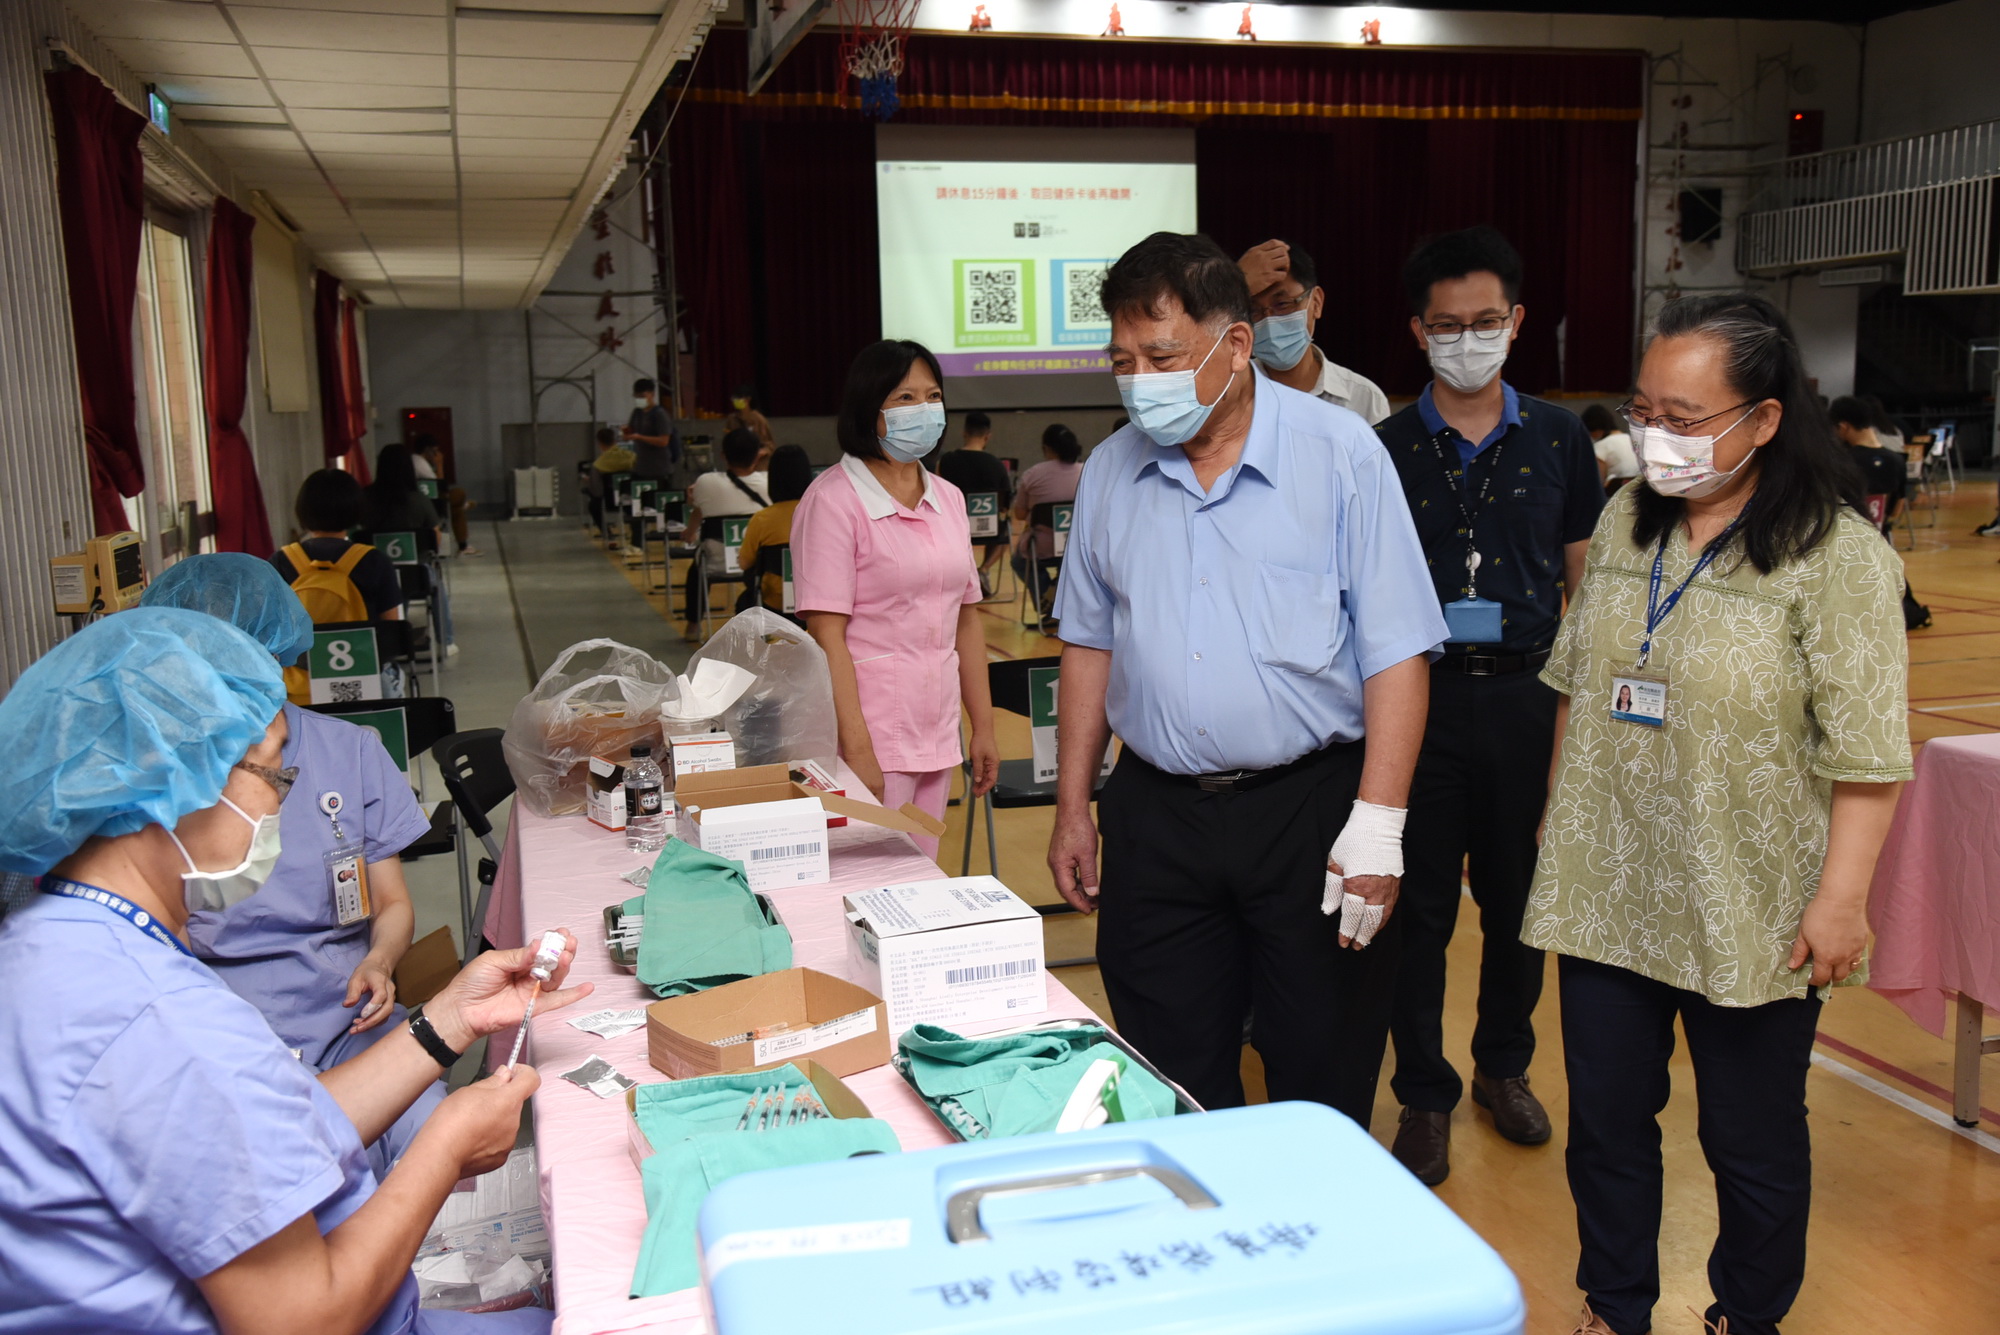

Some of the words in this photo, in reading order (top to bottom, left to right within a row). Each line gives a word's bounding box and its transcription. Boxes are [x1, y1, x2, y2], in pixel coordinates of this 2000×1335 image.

[972, 497, 993, 513] 25
[1058, 510, 1072, 528] 2
[386, 538, 402, 558] 6
[327, 640, 355, 671] 8
[759, 1041, 768, 1058] SOL
